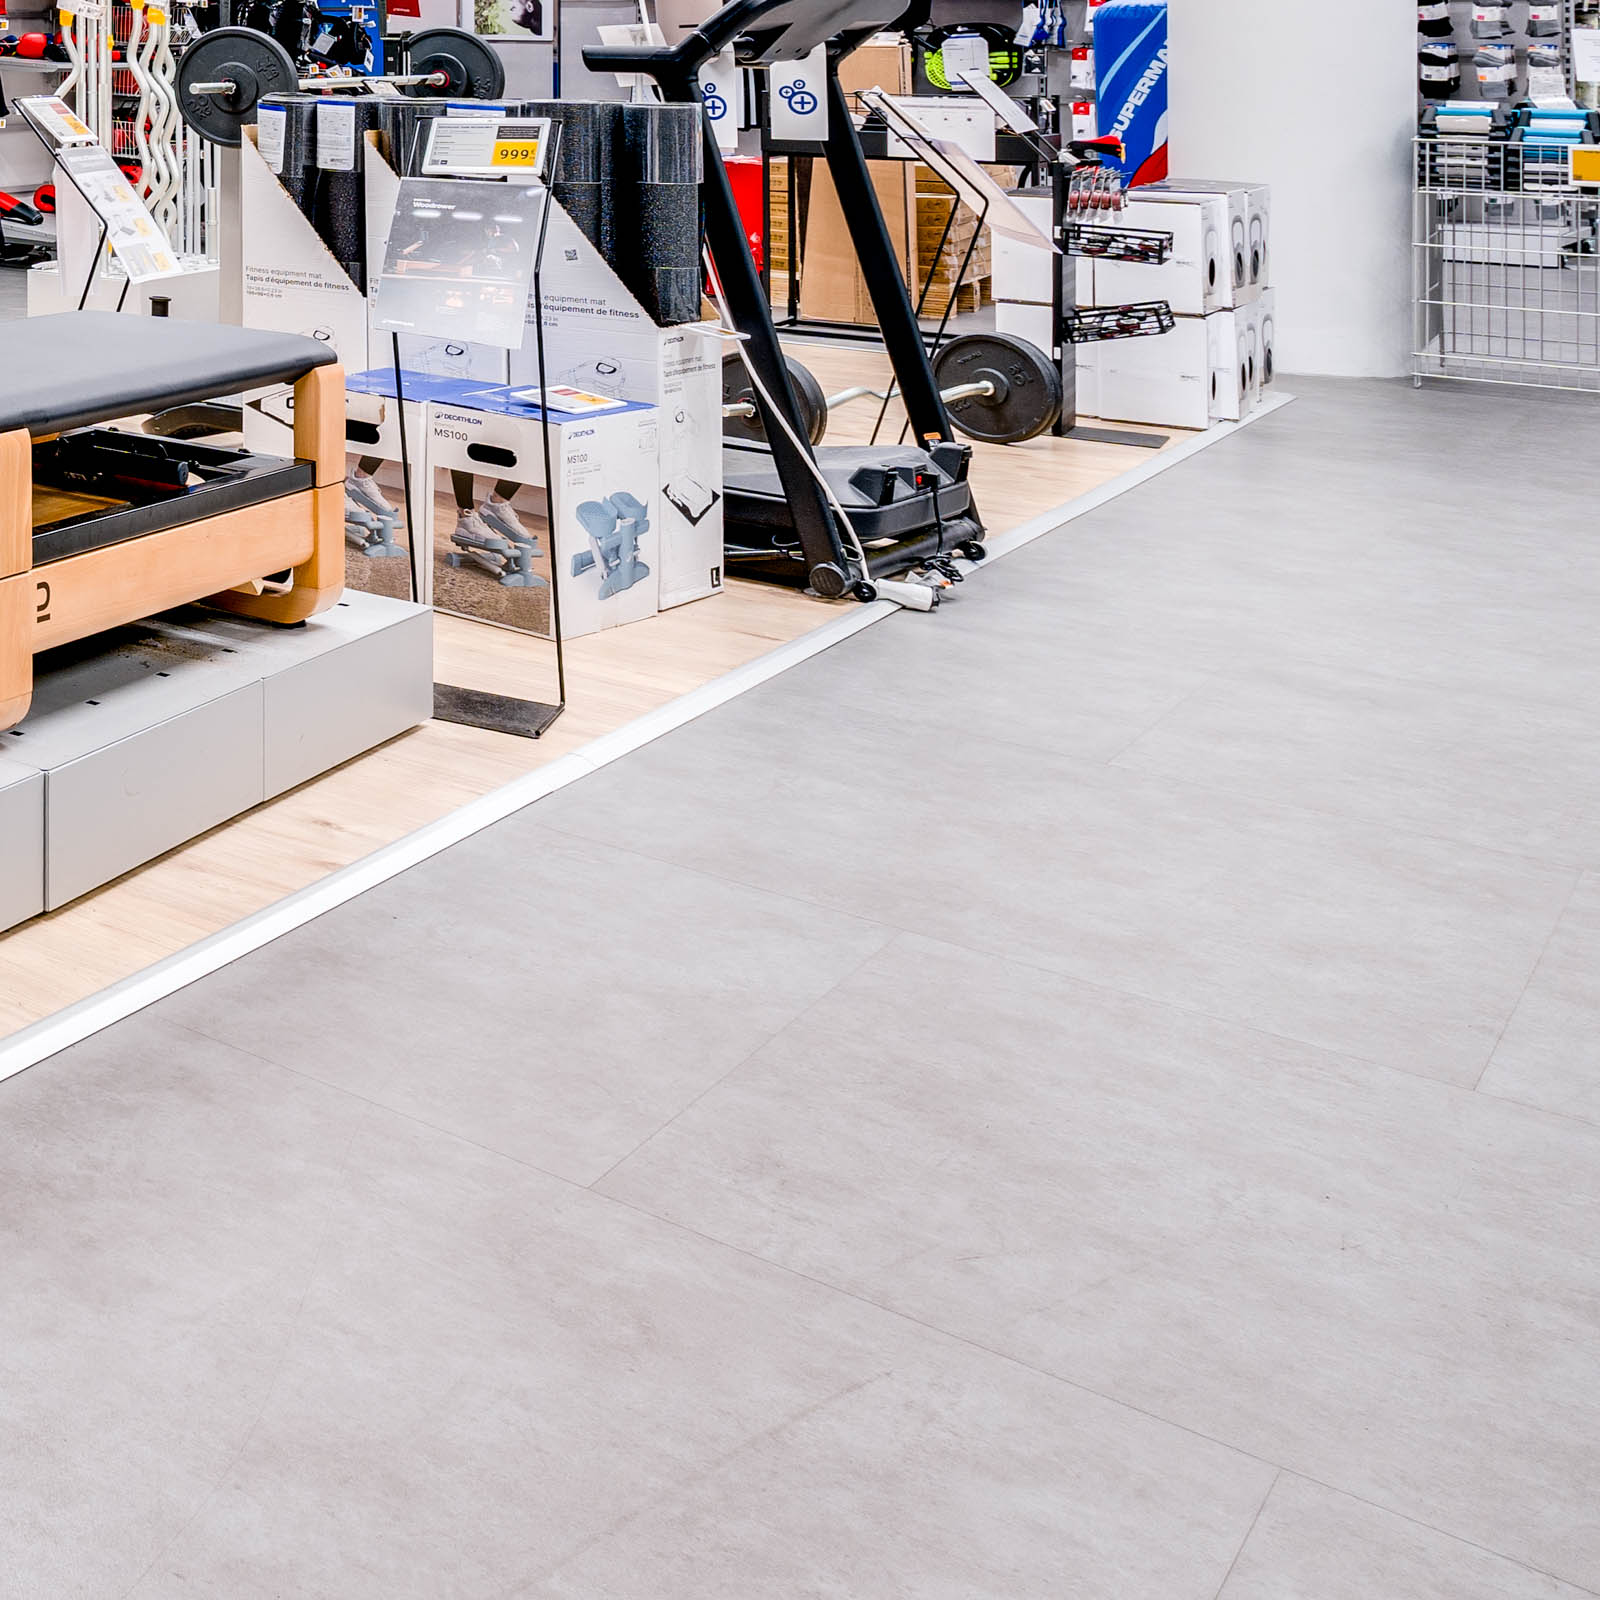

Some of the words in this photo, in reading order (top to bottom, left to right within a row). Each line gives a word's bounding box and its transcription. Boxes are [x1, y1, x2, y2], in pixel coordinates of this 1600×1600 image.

[499, 148, 530, 160] 999
[245, 265, 270, 275] Fitness
[270, 267, 308, 279] equipment
[308, 271, 322, 280] mat
[246, 273, 264, 284] Tapis
[264, 274, 312, 288] d'équipement
[313, 279, 323, 288] de
[324, 281, 350, 291] fitness
[543, 294, 588, 306] equipment
[589, 297, 606, 306] mat
[596, 307, 607, 315] de
[609, 307, 640, 319] fitness
[443, 413, 483, 426] DECATHLON
[434, 427, 468, 442] MS100
[567, 453, 589, 464] MS100
